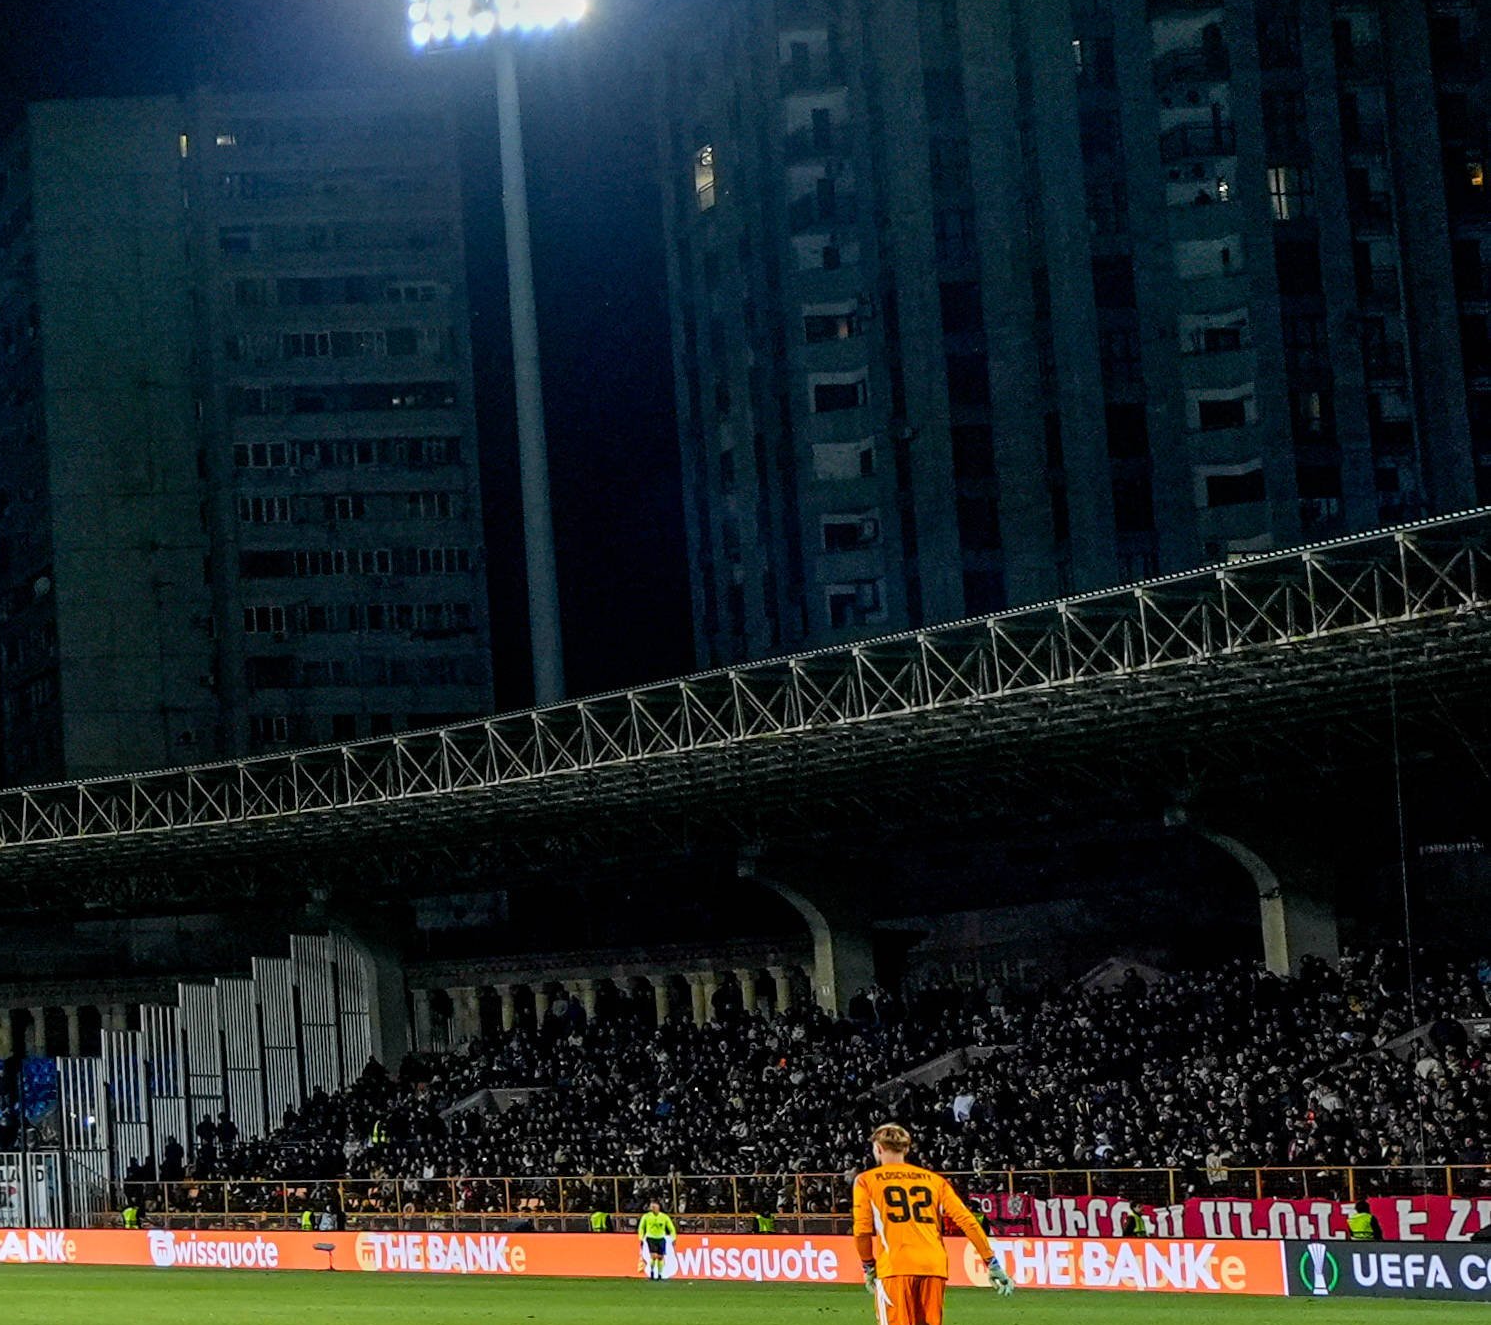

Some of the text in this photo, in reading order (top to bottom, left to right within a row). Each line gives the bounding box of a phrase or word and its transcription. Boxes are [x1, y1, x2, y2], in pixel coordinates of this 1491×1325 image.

[883, 1185, 935, 1224] 92
[368, 1234, 511, 1273] THE BANK
[991, 1239, 1221, 1290] THE BANK
[1352, 1252, 1491, 1292] UEFA C
